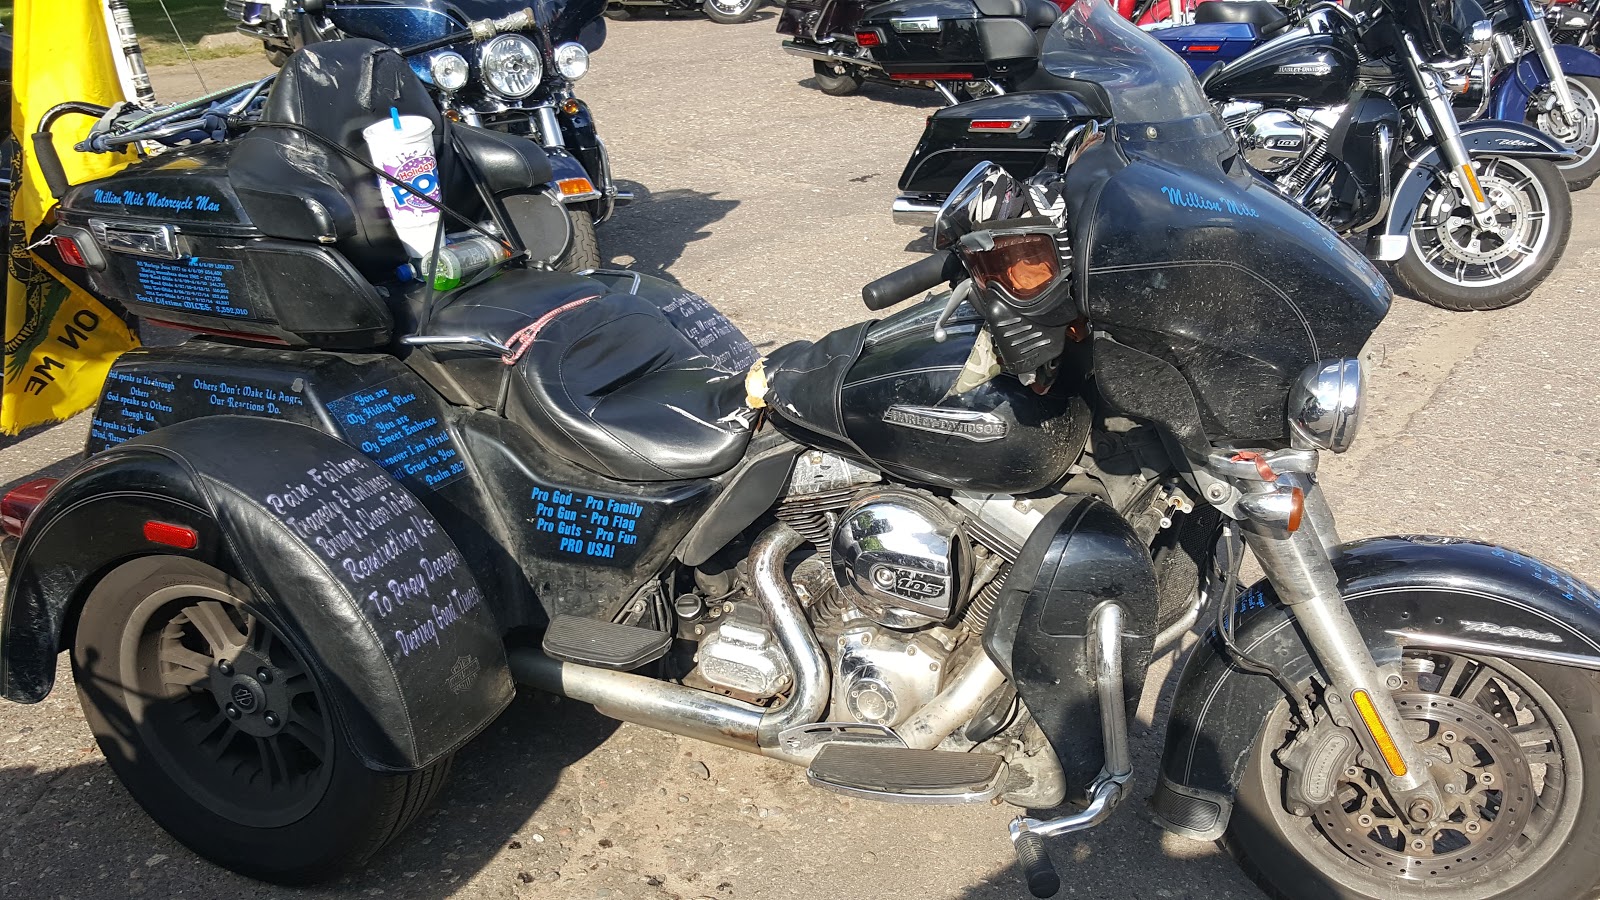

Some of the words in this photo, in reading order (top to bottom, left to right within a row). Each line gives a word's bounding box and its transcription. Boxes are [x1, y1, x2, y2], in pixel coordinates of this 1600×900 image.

[400, 160, 434, 180] Holiday
[94, 188, 122, 204] Million
[123, 190, 144, 206] Mile
[146, 191, 193, 214] Motorcycle
[195, 195, 220, 212] Man
[1160, 186, 1221, 212] Million
[1219, 197, 1259, 218] Mile
[136, 293, 154, 303] Total
[155, 297, 182, 307] Lifetime
[183, 302, 212, 312] MILES:
[118, 373, 135, 383] speaks
[143, 376, 151, 385] Us
[152, 377, 175, 392] through
[130, 386, 150, 398] Others
[193, 379, 218, 392] Others
[220, 382, 241, 394] Don't
[242, 386, 263, 399] Make
[265, 389, 277, 400] Us
[106, 391, 119, 402] God
[120, 395, 140, 406] speaks
[149, 400, 173, 413] Others
[210, 394, 225, 406] Our
[227, 396, 265, 412] Reactions
[267, 402, 281, 414] Do.
[346, 412, 366, 425] My
[363, 401, 396, 419] Hiding
[392, 392, 416, 407] Place
[354, 393, 375, 406] You
[376, 387, 389, 399] are
[103, 420, 120, 430] speaks
[127, 424, 135, 434] Us
[121, 408, 144, 421] though
[145, 412, 155, 422] Us
[375, 421, 395, 434] You
[396, 414, 410, 425] are
[361, 441, 381, 453] My
[378, 429, 404, 446] Sweet
[401, 416, 438, 436] Embrace
[406, 445, 416, 456] I
[415, 443, 427, 453] am
[425, 430, 450, 448] Afraid
[403, 458, 429, 475] Trust
[429, 455, 439, 466] in
[438, 448, 456, 461] You
[425, 470, 451, 486] Psalm
[450, 460, 466, 474] 32:7
[267, 484, 318, 515] Pain,
[307, 458, 369, 488] Failure,
[286, 499, 346, 539] Tragedy
[332, 490, 351, 509] &
[531, 487, 550, 502] Pro
[552, 490, 573, 506] God
[585, 495, 604, 510] Pro
[607, 499, 644, 518] Family
[316, 526, 361, 560] Bring
[343, 518, 368, 540] Us
[356, 506, 393, 531] Closer
[380, 495, 402, 516] To
[536, 502, 554, 517] Pro
[557, 506, 577, 521] Gun
[590, 512, 609, 527] Pro
[612, 515, 636, 532] Flag
[536, 517, 555, 533] Pro
[557, 521, 582, 537] Guts
[595, 527, 614, 542] Pro
[617, 530, 638, 545] Fun
[343, 528, 424, 583] Reminding
[560, 537, 584, 554] PRO
[586, 541, 616, 559] USA!
[368, 590, 393, 617] To
[388, 573, 429, 605] Pray
[420, 549, 460, 583] Deeper
[898, 578, 944, 596] 103
[396, 620, 440, 656] During
[432, 595, 457, 629] Good
